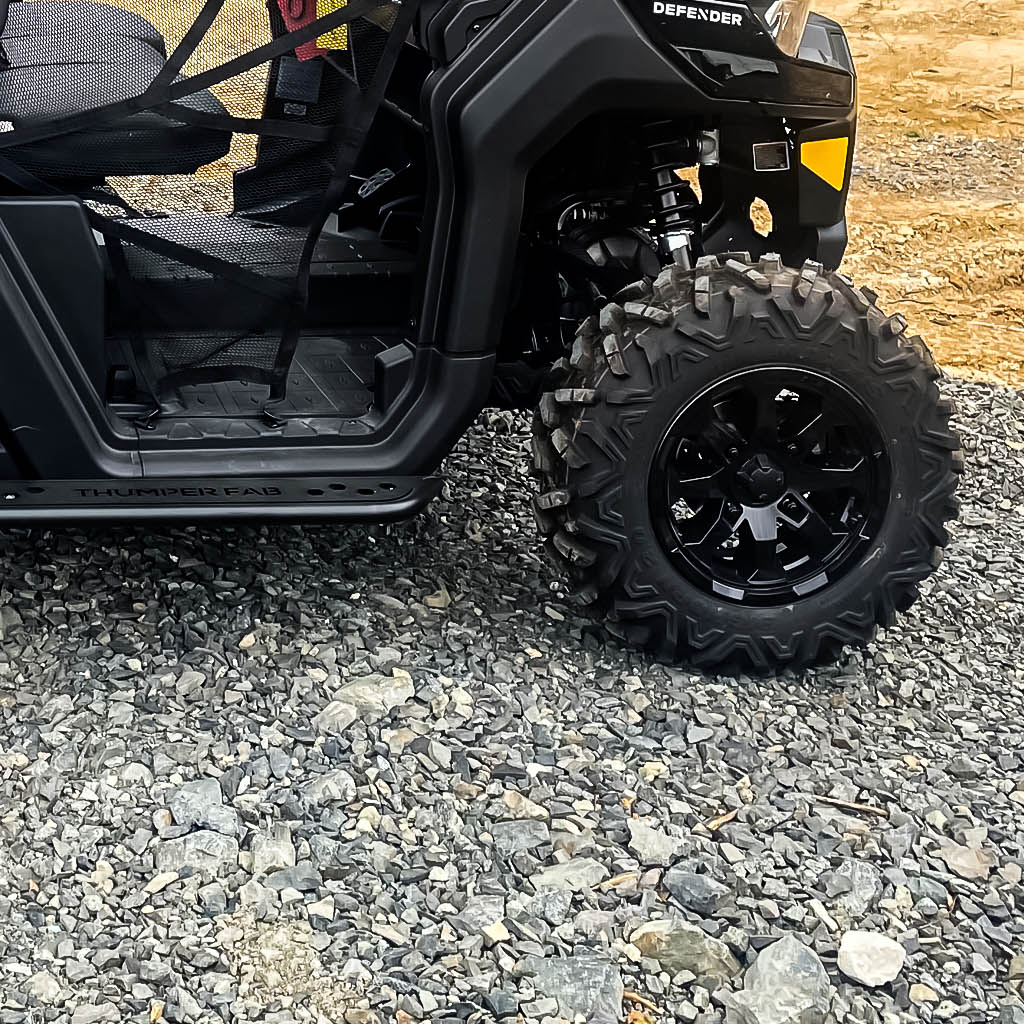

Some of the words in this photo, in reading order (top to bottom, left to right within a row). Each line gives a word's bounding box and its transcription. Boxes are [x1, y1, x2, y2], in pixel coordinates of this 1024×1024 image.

[653, 1, 743, 26] DEFENDER
[74, 487, 218, 497] THUMPER
[223, 486, 283, 496] FAB
